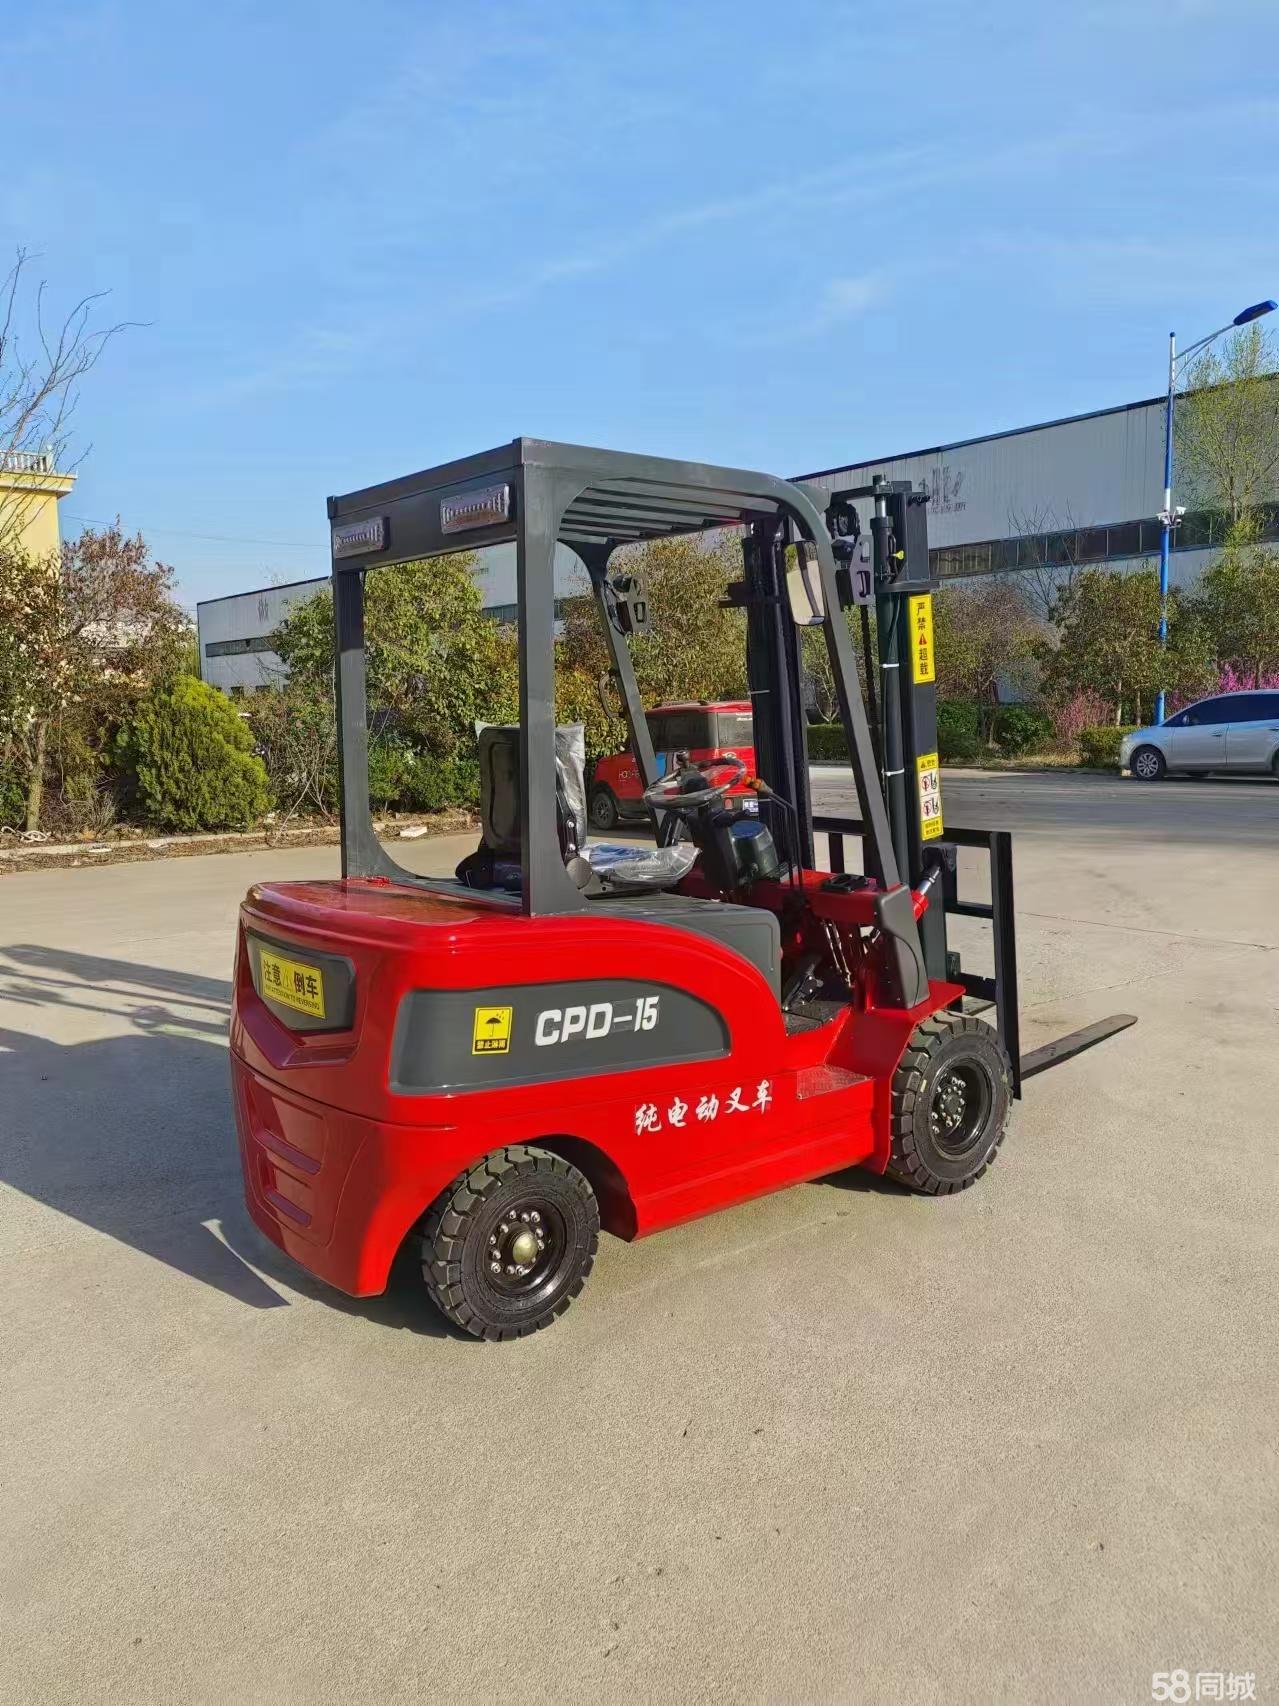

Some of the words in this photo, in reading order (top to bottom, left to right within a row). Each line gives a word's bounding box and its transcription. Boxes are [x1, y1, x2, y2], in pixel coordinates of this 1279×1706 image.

[915, 602, 926, 630] 严禁
[919, 648, 929, 675] 超载
[263, 959, 282, 986] 注意
[294, 970, 319, 999] 倒车
[535, 996, 659, 1047] CPD-15
[635, 1079, 772, 1136] 纯电动叉车
